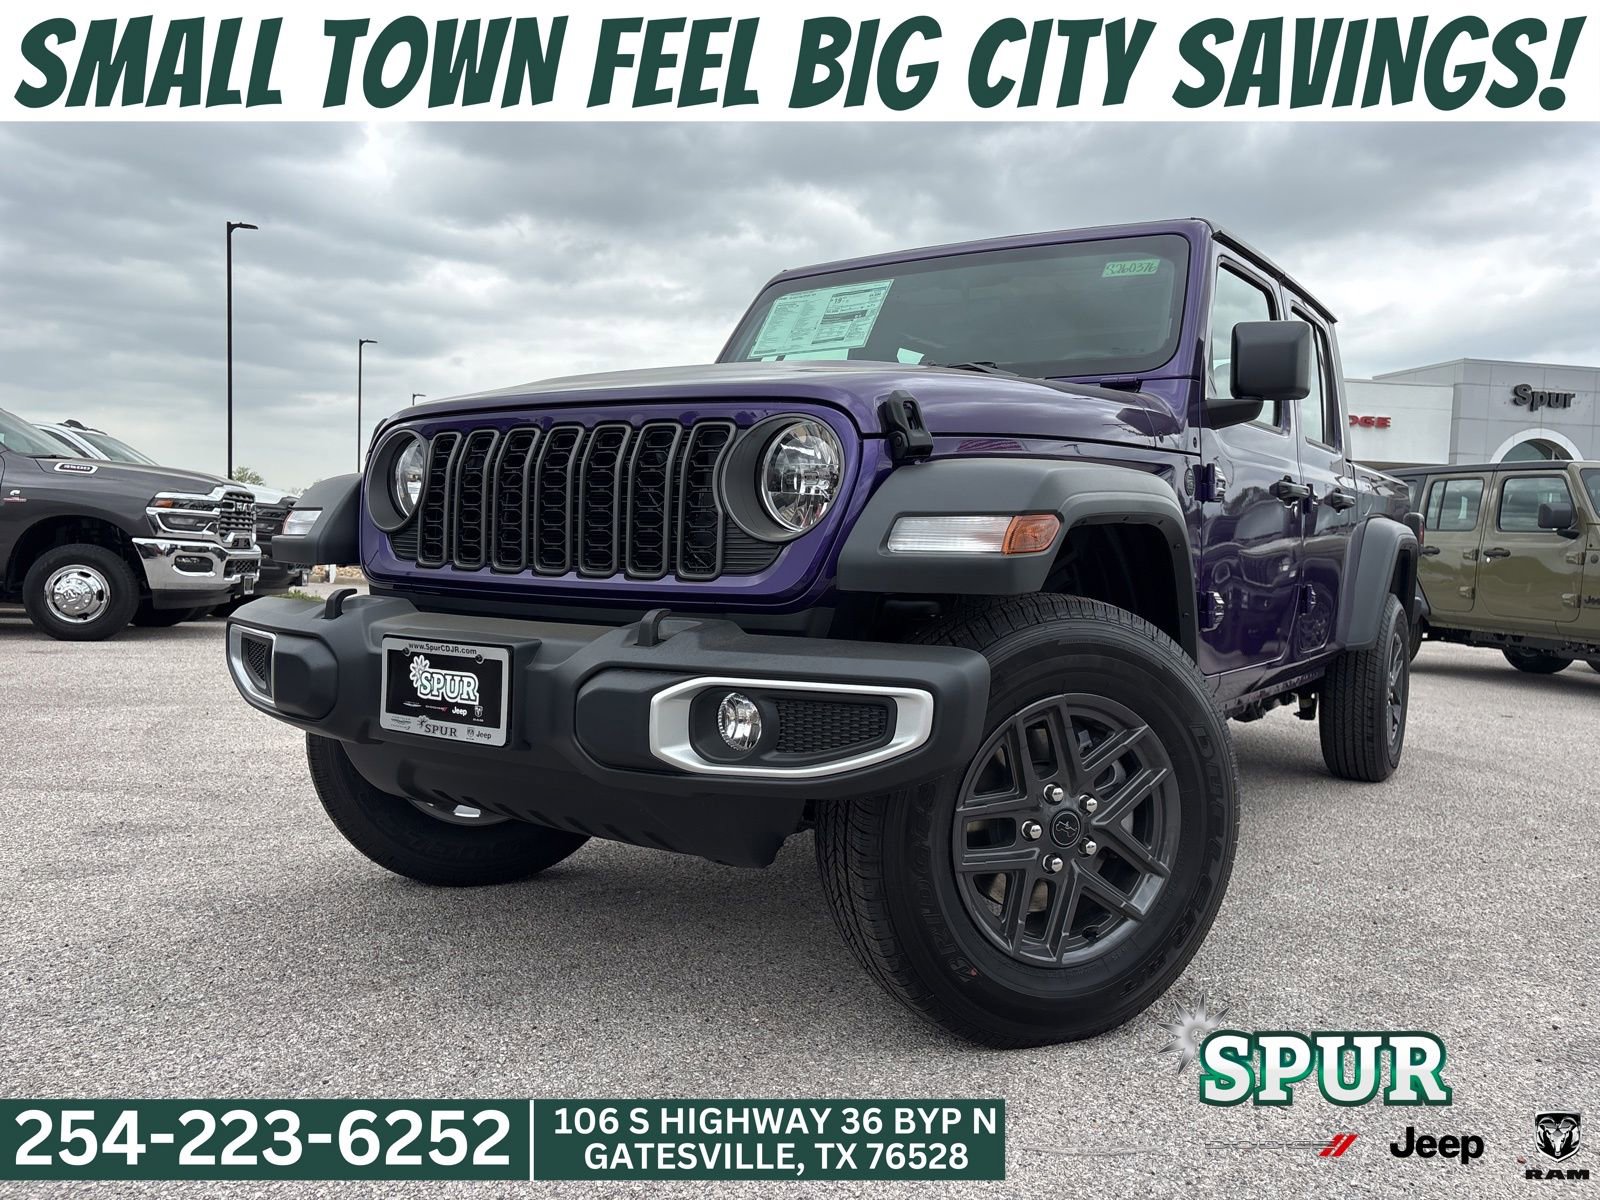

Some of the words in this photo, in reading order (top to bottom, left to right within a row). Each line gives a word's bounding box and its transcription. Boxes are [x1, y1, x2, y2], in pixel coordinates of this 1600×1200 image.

[1512, 383, 1576, 412] Spur
[1348, 414, 1392, 429] DGE
[408, 642, 477, 655] www.SpurCDJR.com
[419, 671, 478, 701] SPUR
[452, 706, 468, 717] Jeep
[424, 723, 458, 737] SPUR
[476, 730, 492, 740] Jeep
